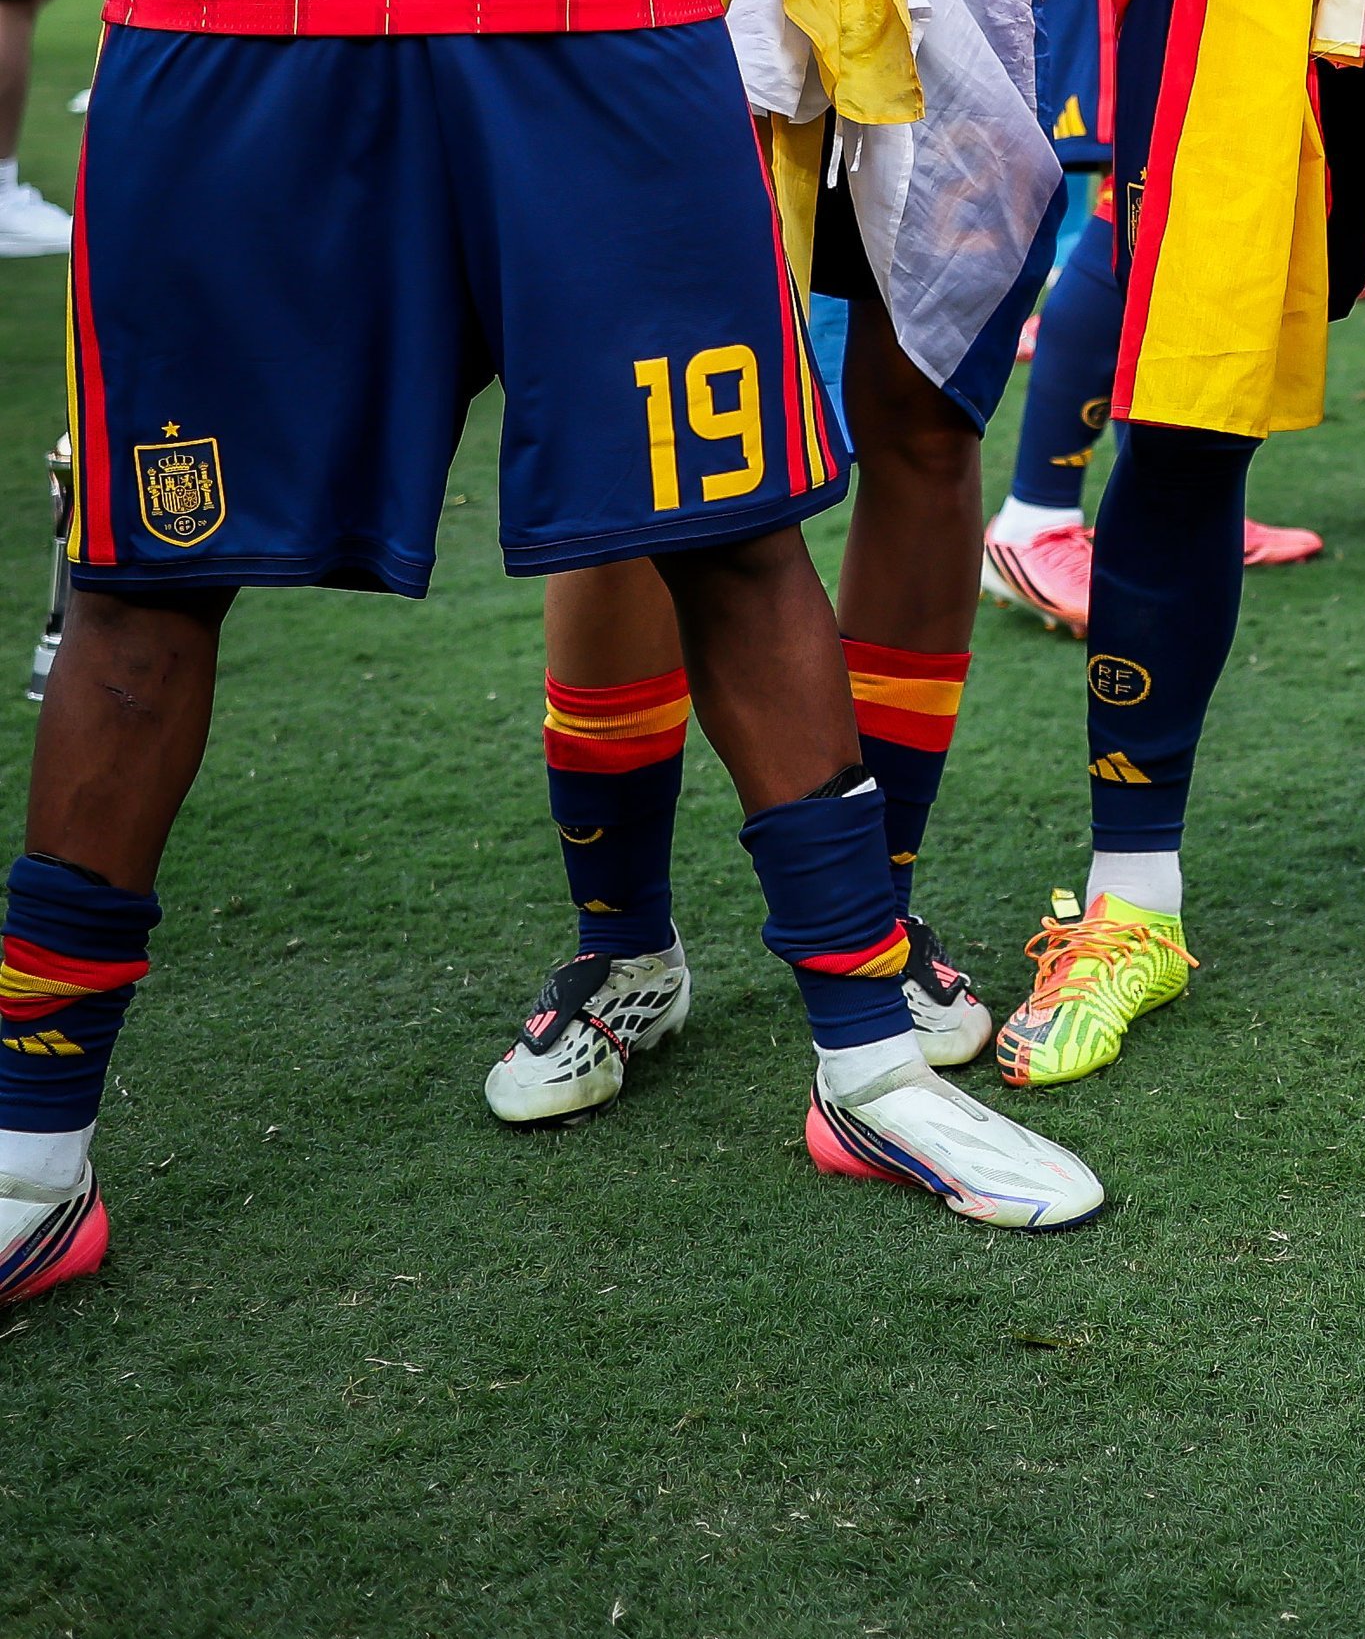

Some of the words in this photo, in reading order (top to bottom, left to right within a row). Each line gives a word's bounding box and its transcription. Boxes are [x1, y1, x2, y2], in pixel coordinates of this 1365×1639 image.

[632, 343, 765, 513] 19
[1098, 663, 1133, 681] RF
[1098, 677, 1132, 695] EF
